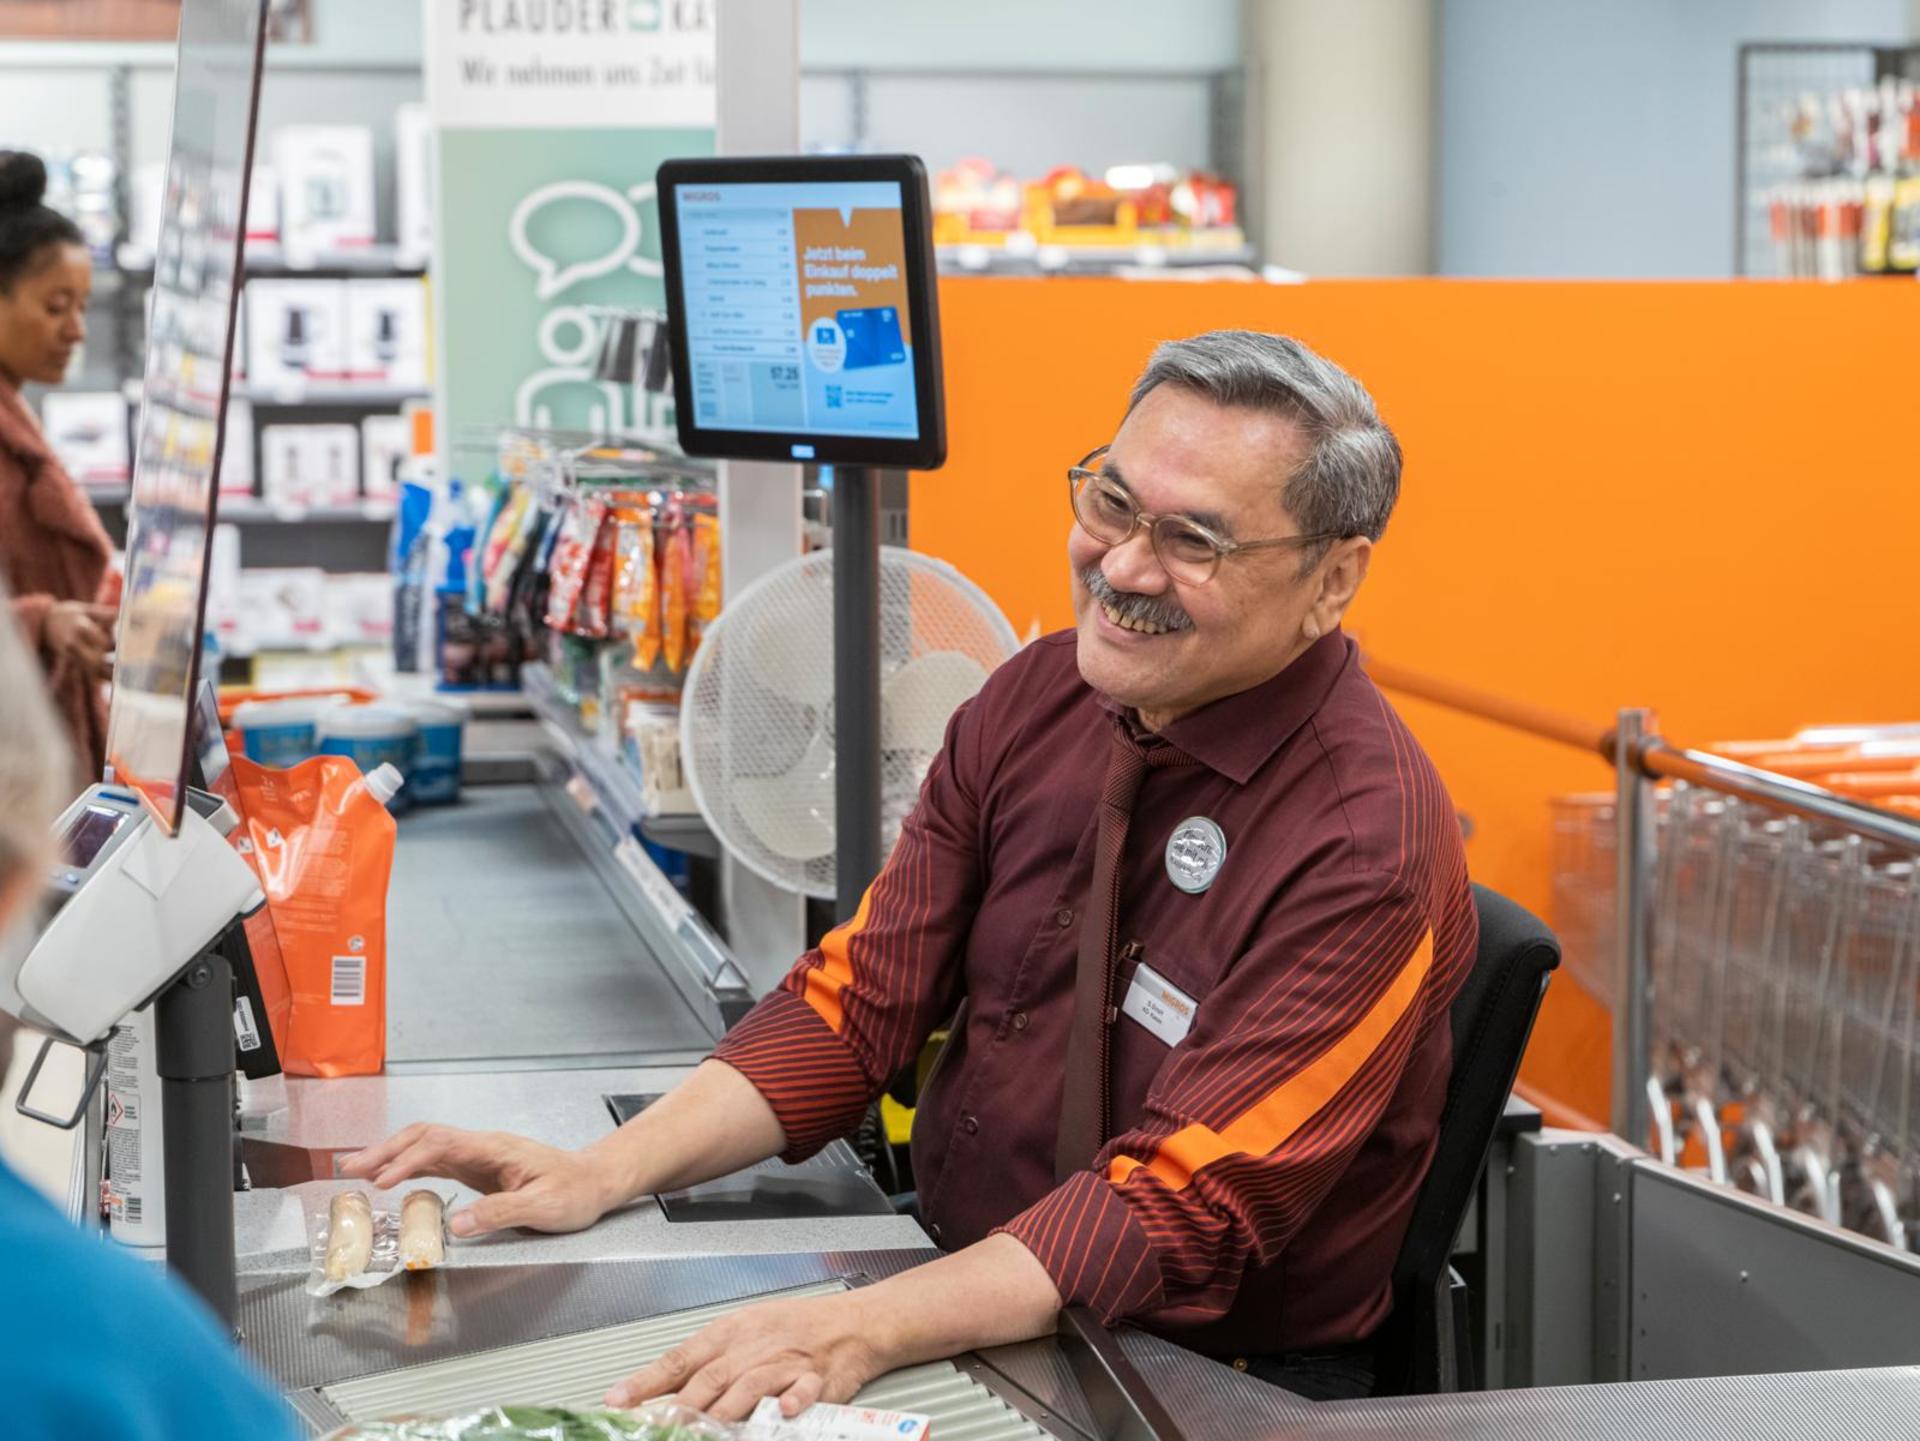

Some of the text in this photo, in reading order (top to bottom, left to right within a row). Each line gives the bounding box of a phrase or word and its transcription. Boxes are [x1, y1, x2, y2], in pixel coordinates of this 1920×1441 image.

[459, 0, 618, 33] PLAUDER
[459, 55, 495, 86] Wir
[507, 53, 594, 86] nehmen
[604, 63, 642, 86] uns
[804, 246, 866, 262] Jetzt beim
[804, 264, 898, 283] Einkauf doppelt
